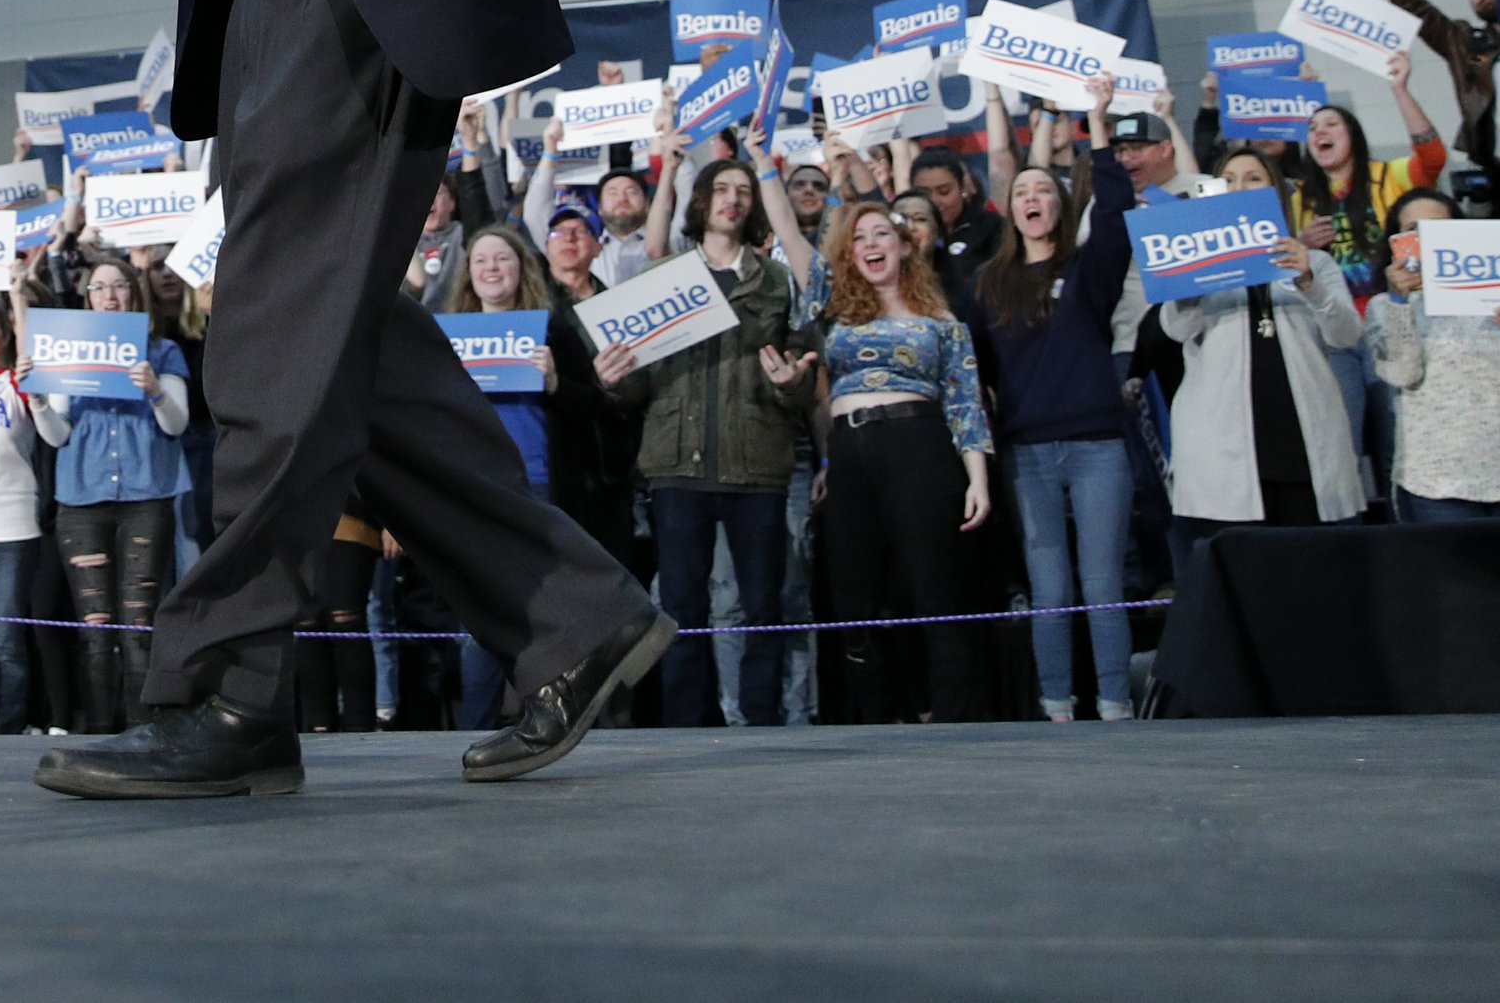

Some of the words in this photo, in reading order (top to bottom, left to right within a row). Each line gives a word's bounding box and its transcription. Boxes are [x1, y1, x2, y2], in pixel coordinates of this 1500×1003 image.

[675, 10, 762, 37] Bernie
[879, 1, 961, 41] Bernie
[980, 23, 1101, 77] Bernie
[1213, 41, 1299, 64] Bernie
[680, 63, 752, 128] Bernie
[1114, 72, 1159, 92] nie
[563, 96, 654, 124] Bernie
[831, 77, 930, 121] Bernie
[514, 137, 599, 161] Benie
[95, 191, 196, 219] Bernie
[16, 213, 57, 236] nie
[1141, 215, 1279, 267] Bernie
[1433, 248, 1500, 279] Ber
[597, 282, 712, 346] Bernie
[32, 334, 138, 366] Bernie
[451, 331, 536, 360] ernie
